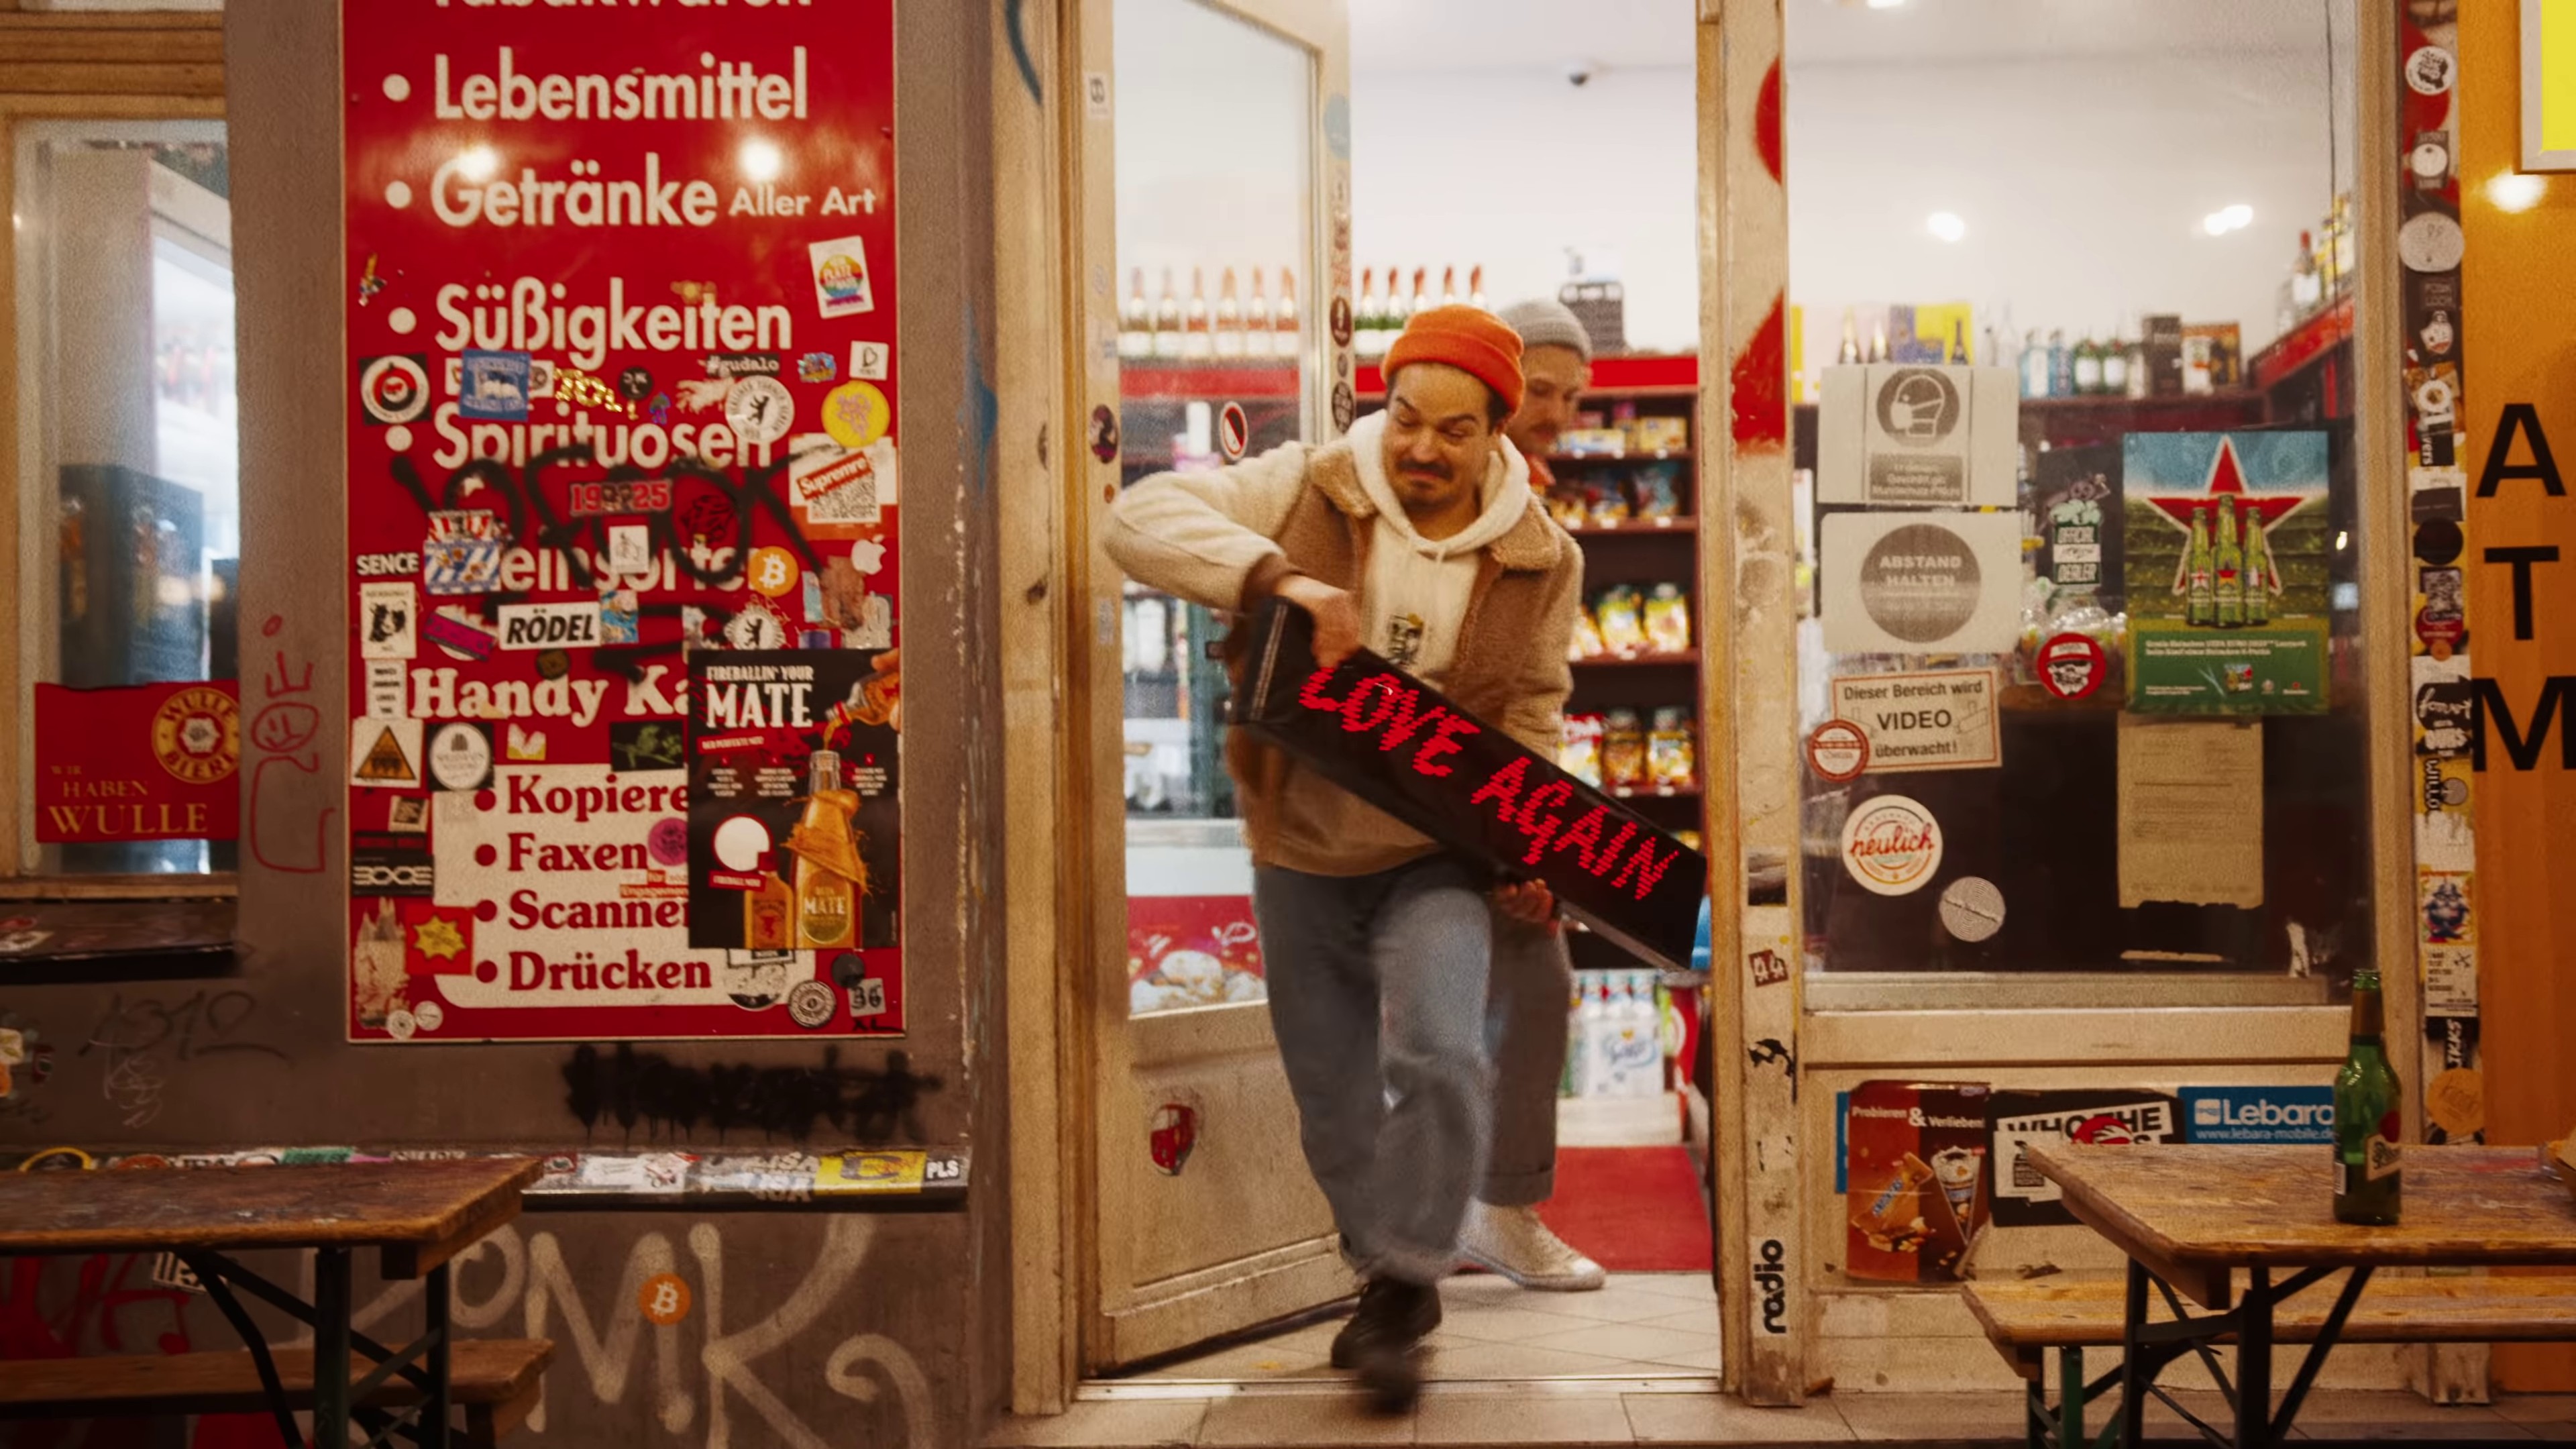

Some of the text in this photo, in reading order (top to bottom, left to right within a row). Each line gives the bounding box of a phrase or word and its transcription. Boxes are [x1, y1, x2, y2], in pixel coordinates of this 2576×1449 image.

[434, 46, 807, 120] Lebensmittel
[431, 152, 875, 227] Getränke Aller Art
[434, 276, 793, 372] Süßigkeiten
[433, 401, 771, 493] Spirituosen
[1879, 555, 1962, 569] ABSTAND
[1885, 575, 1955, 587] HALTEN
[506, 608, 594, 645] RÖDEL
[780, 664, 814, 681] YOUR
[410, 666, 609, 727] Handy
[706, 682, 814, 729] MATE
[1844, 680, 1982, 700] Dieser Bereich wird
[162, 692, 235, 721] WULLE
[1876, 709, 1952, 731] VIDEO
[1875, 740, 1957, 758] überwacht!
[50, 765, 82, 776] WIR
[1299, 667, 1678, 900] LOVE AGAIN
[63, 780, 149, 798] HABEN
[48, 804, 208, 835] WULLE
[507, 833, 648, 871] Faxen
[1849, 822, 1935, 857] neulich
[508, 889, 688, 930] Scanne
[804, 896, 846, 915] MATE
[508, 949, 712, 991] Drücken
[1851, 1106, 1907, 1119] Probieren
[1909, 1106, 1927, 1128] &
[2222, 1098, 2335, 1125] Lebara
[926, 1159, 959, 1179] PLS
[1754, 1239, 1787, 1334] radio
